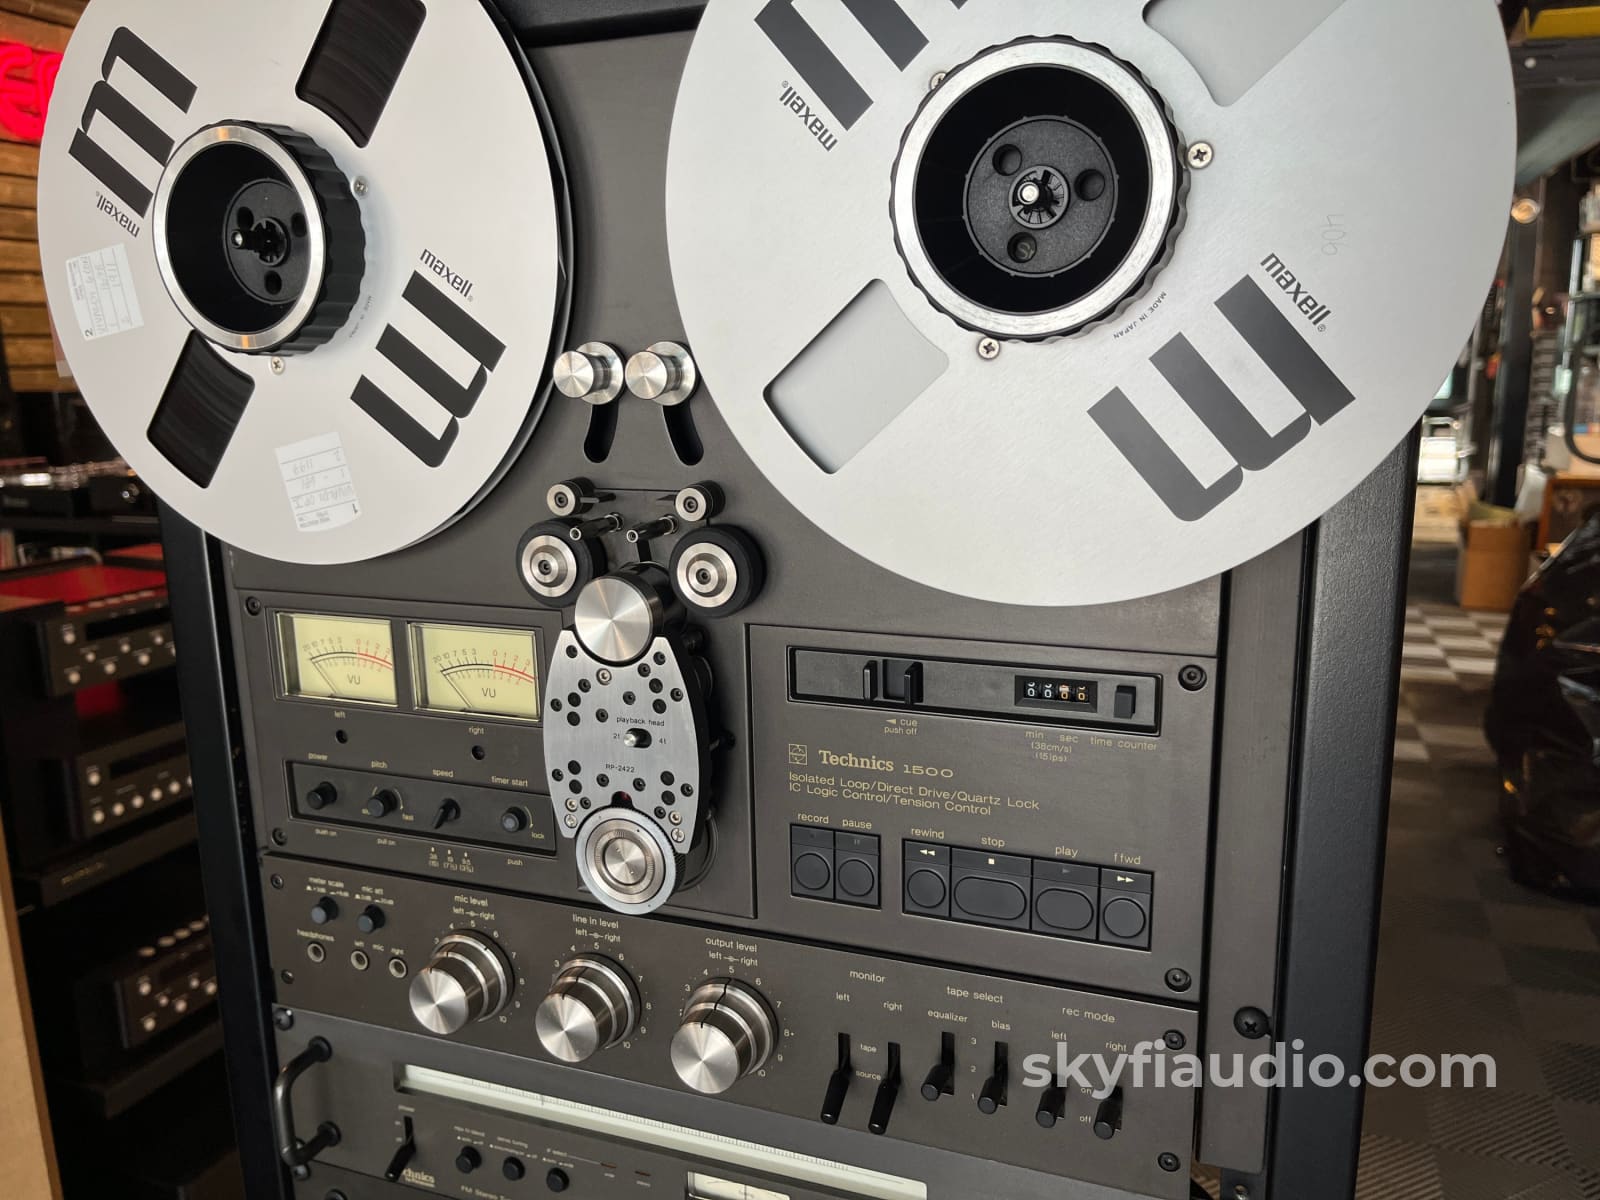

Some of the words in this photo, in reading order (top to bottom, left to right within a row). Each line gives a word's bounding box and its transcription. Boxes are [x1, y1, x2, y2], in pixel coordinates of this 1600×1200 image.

[779, 86, 838, 152] maxell
[97, 195, 140, 237] maxell
[420, 248, 473, 298] maxell
[1260, 252, 1331, 326] maxell
[1149, 291, 1167, 314] MADE
[1139, 313, 1148, 323] IN
[85, 328, 95, 337] 2
[1113, 321, 1138, 340] JAPAN
[347, 674, 361, 685] VU
[482, 688, 496, 698] VU
[334, 710, 346, 719] left
[616, 716, 646, 726] playback
[648, 718, 665, 727] head
[900, 718, 918, 727] cue
[469, 726, 485, 736] right
[884, 726, 904, 736] push
[906, 726, 918, 735] off
[1025, 730, 1044, 740] min
[1059, 734, 1079, 743] sec
[1090, 736, 1113, 747] time
[1117, 739, 1158, 751] counter
[605, 763, 635, 773] RP-2422
[818, 749, 894, 772] Technics
[903, 764, 954, 778] 1500
[432, 769, 454, 778] speed
[491, 776, 509, 785] timer
[511, 779, 529, 787] start
[789, 771, 835, 786] Isolated
[840, 777, 914, 796] Loop/Direct
[919, 786, 1001, 806] Drive/Quartz
[1007, 797, 1040, 810] Lock
[789, 782, 801, 793] IC
[807, 784, 839, 799] Logic
[842, 789, 940, 809] Control/Tension
[944, 801, 992, 816] Control
[798, 812, 829, 824] record
[842, 817, 872, 830] pause
[911, 826, 945, 840] rewind
[981, 836, 1005, 849] stop
[1055, 845, 1079, 858] play
[454, 895, 468, 904] mic
[469, 896, 488, 907] level
[480, 912, 495, 920] right
[572, 914, 587, 924] line
[589, 917, 597, 925] in
[599, 917, 619, 929] level
[575, 927, 588, 937] left
[604, 932, 621, 943] right
[705, 937, 734, 950] output
[736, 941, 757, 953] level
[708, 951, 722, 961] left
[740, 957, 758, 967] right
[849, 970, 886, 984] monitor
[594, 942, 600, 950] 5
[641, 1026, 647, 1034] 9
[835, 992, 850, 1002] left
[946, 986, 969, 999] tape
[973, 991, 1004, 1004] select
[883, 1000, 903, 1012] right
[703, 968, 709, 976] 4
[777, 1054, 783, 1062] 9
[927, 1009, 968, 1023] equalizer
[1062, 1007, 1080, 1017] rec
[1084, 1010, 1116, 1023] mode
[991, 1019, 1011, 1031] bias
[970, 1037, 977, 1045] 3
[1051, 1030, 1067, 1040] left
[860, 1043, 877, 1053] tape
[1105, 1041, 1127, 1052] right
[855, 1069, 882, 1081] source
[970, 1065, 977, 1073] 2
[1080, 1087, 1092, 1095] on
[1079, 1115, 1091, 1123] off
